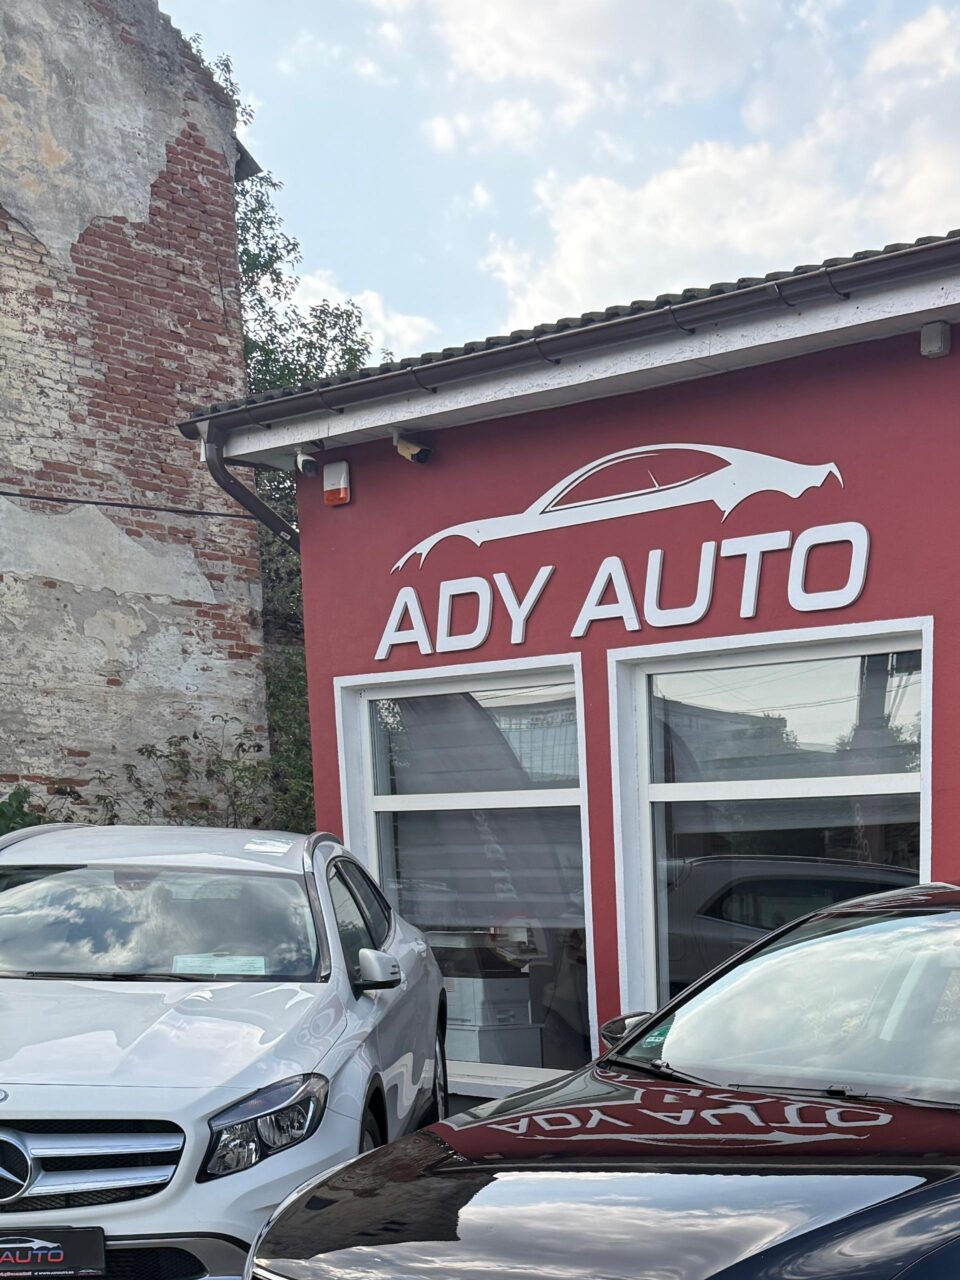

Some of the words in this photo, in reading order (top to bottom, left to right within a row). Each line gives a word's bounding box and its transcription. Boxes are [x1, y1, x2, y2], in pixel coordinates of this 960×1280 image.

[375, 564, 556, 661] ADY
[570, 521, 871, 638] AUTO
[0, 1249, 64, 1264] AUTO
